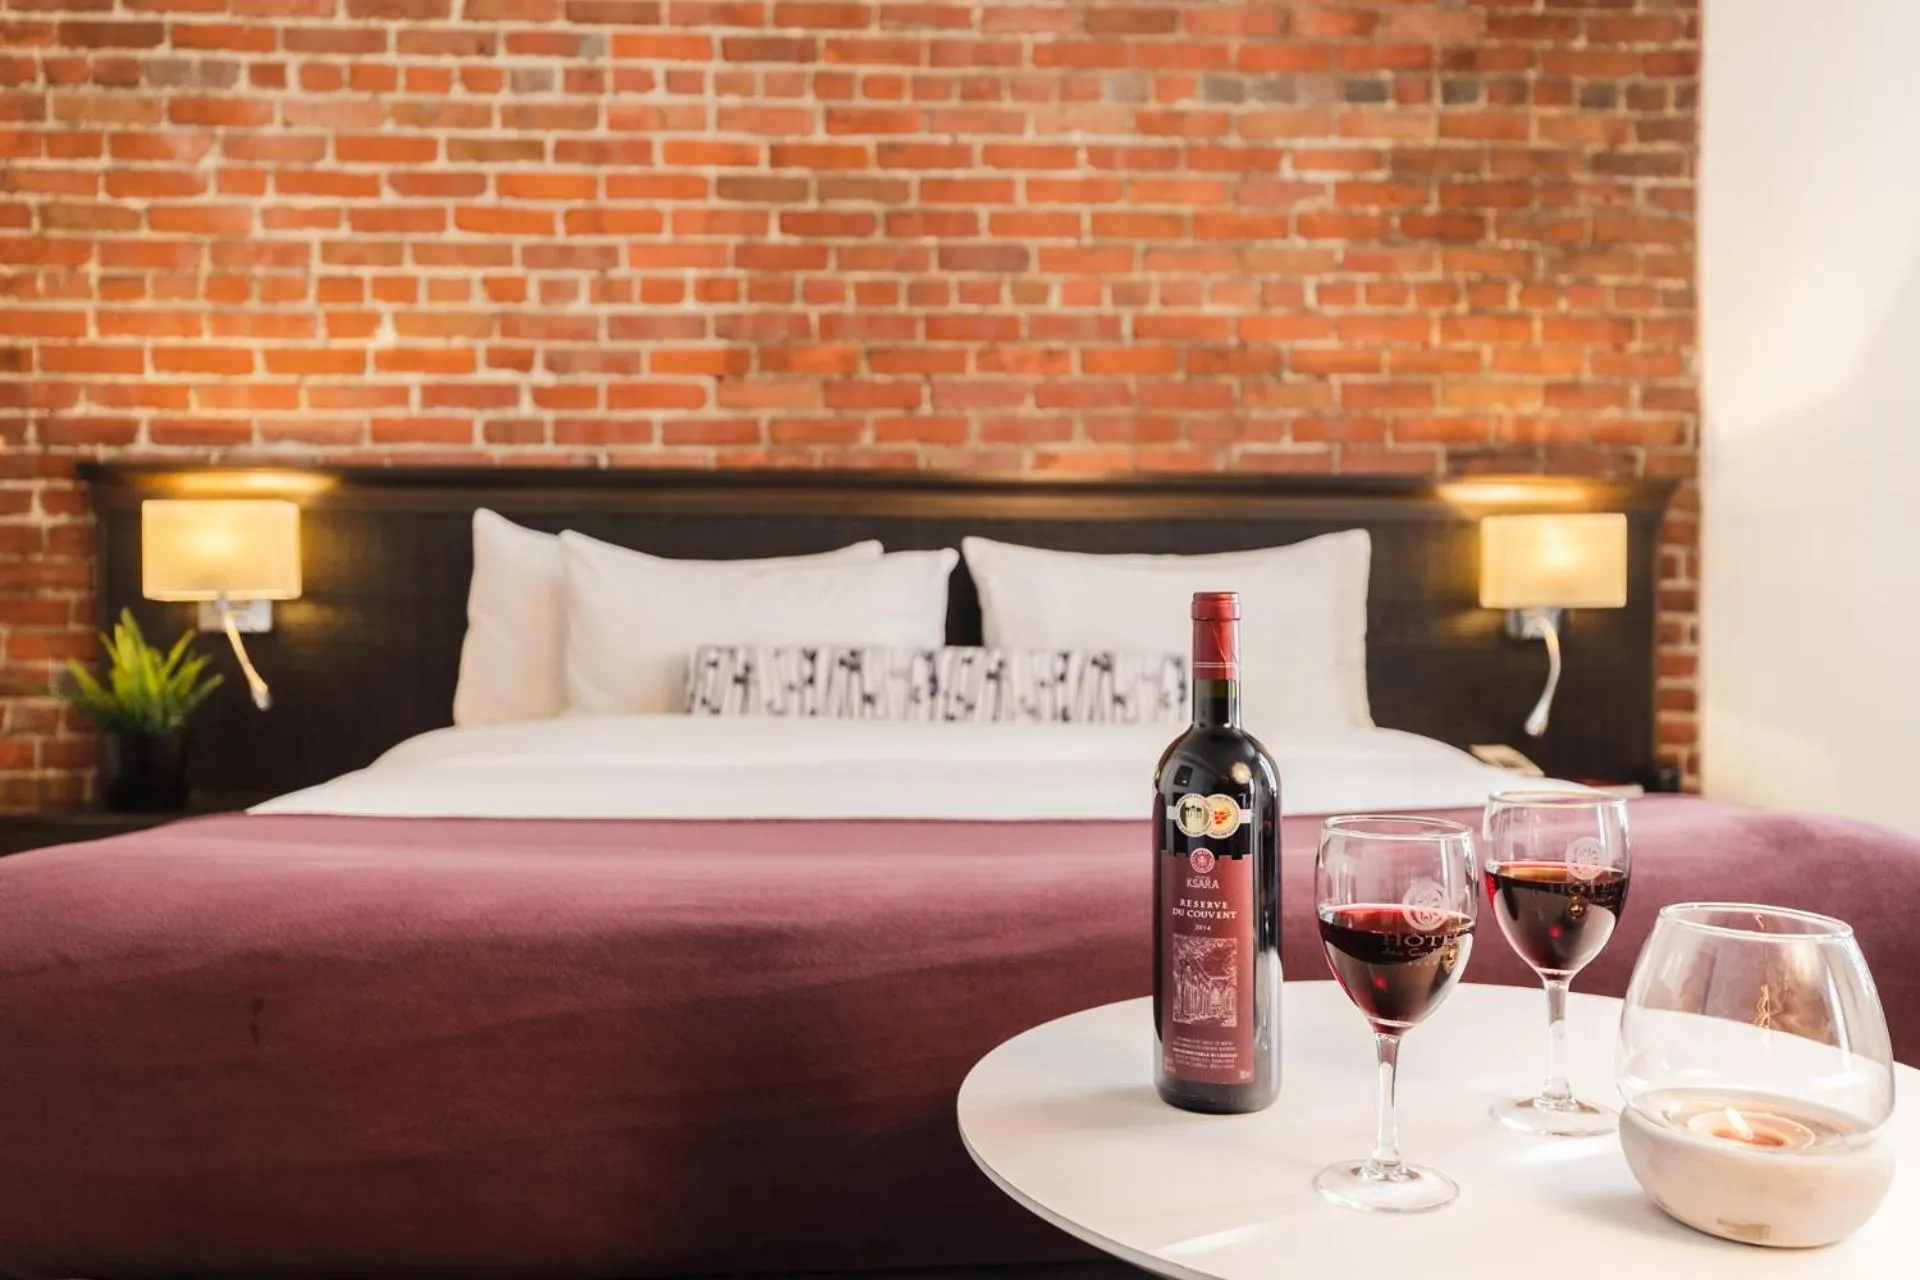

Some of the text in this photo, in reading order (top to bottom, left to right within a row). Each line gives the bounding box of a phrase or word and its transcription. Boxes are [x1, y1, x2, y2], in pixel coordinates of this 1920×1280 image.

[1186, 878, 1220, 889] KSARA
[1180, 898, 1229, 909] RESERVE
[1172, 907, 1238, 919] DU COUVENT
